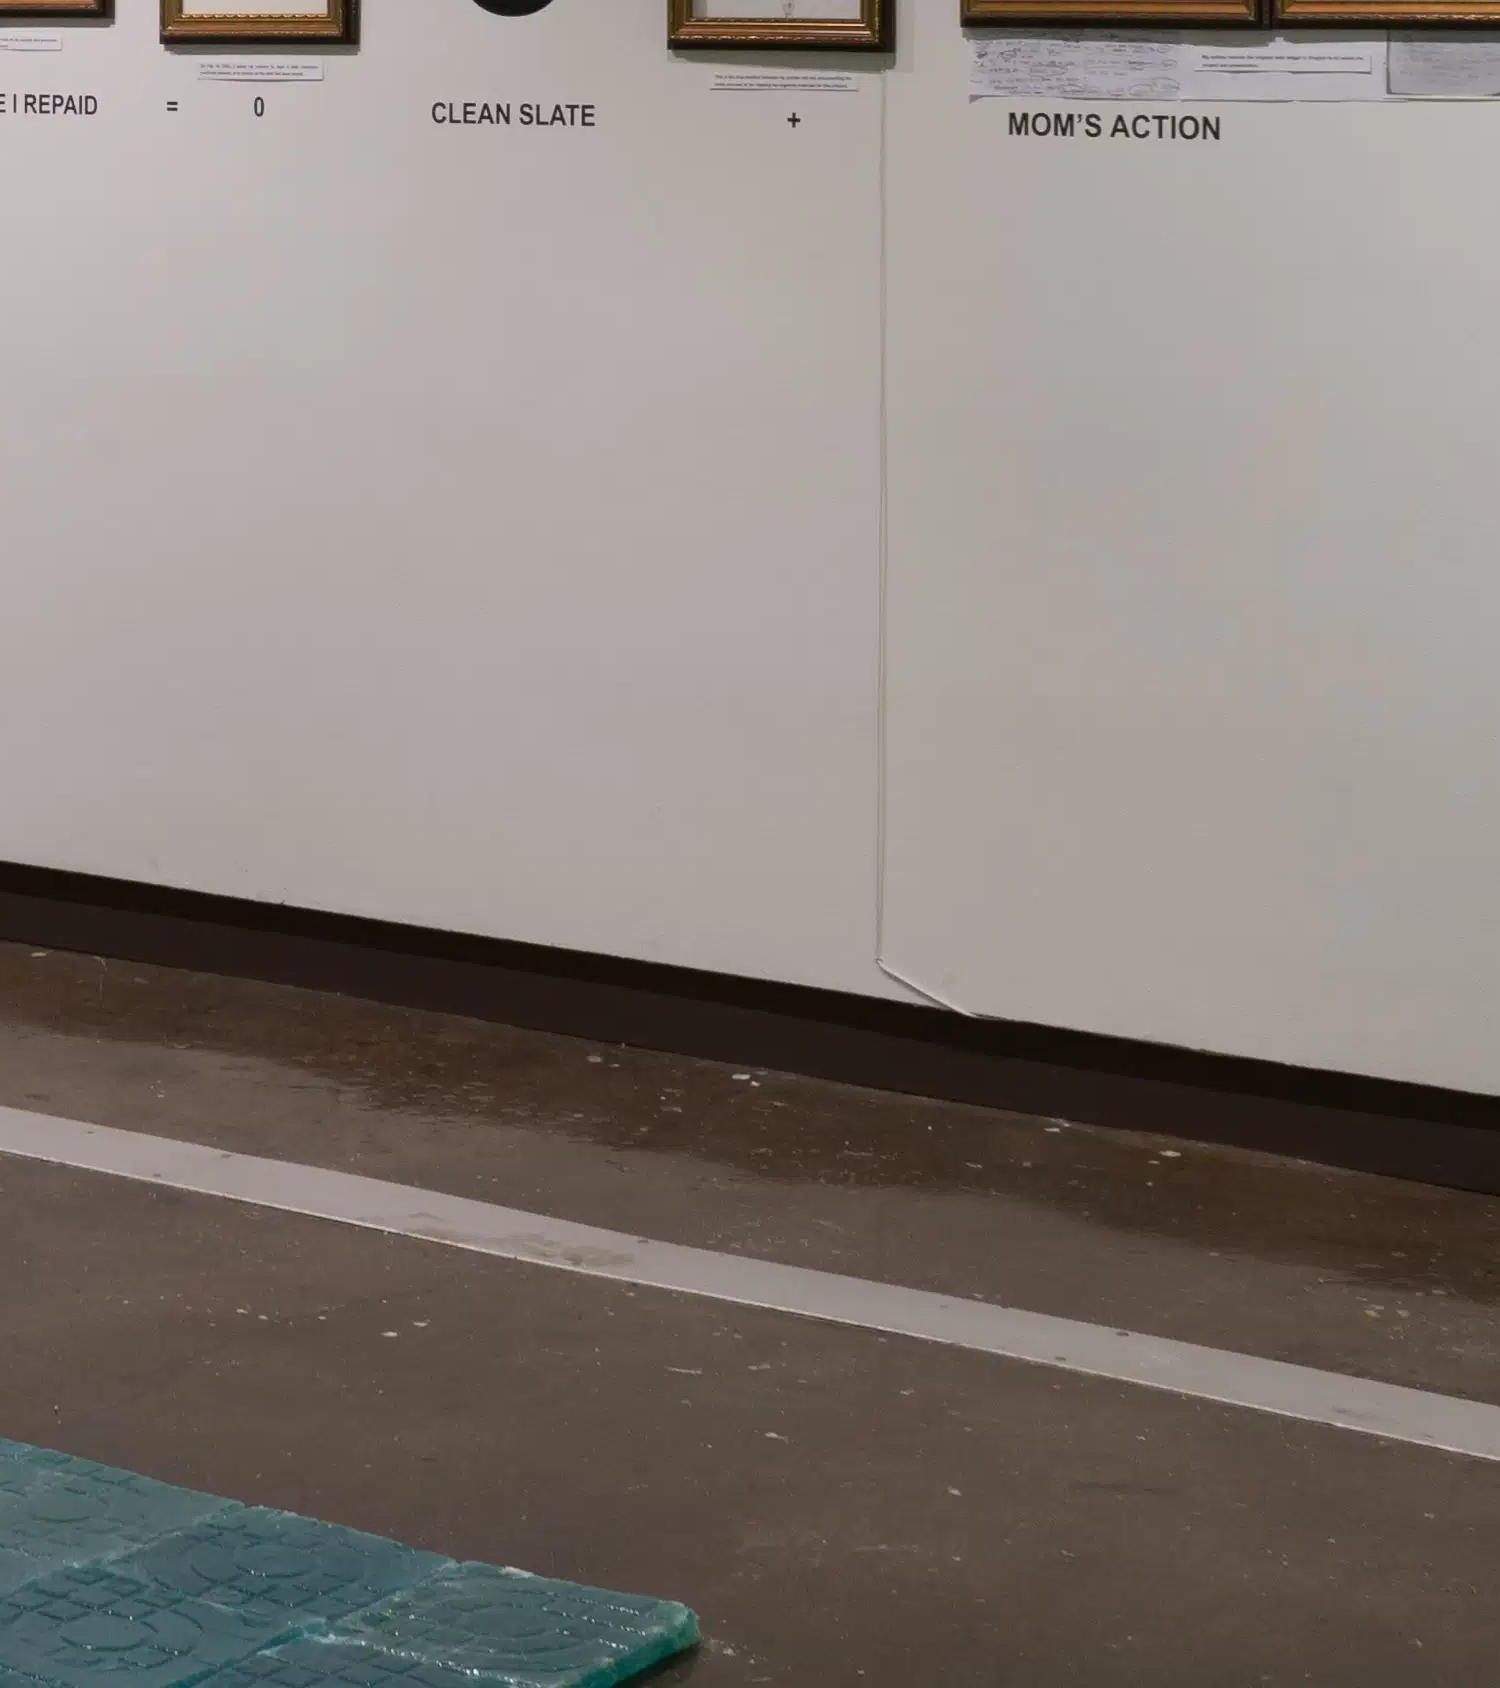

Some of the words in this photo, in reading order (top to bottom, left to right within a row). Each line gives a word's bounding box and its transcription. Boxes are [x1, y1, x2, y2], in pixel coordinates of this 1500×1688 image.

[13, 94, 17, 113] I
[24, 94, 98, 115] REPAID
[432, 102, 510, 125] CLEAN
[519, 103, 596, 127] SLATE
[1009, 113, 1102, 138] MOM’S
[1109, 115, 1221, 140] ACTION
